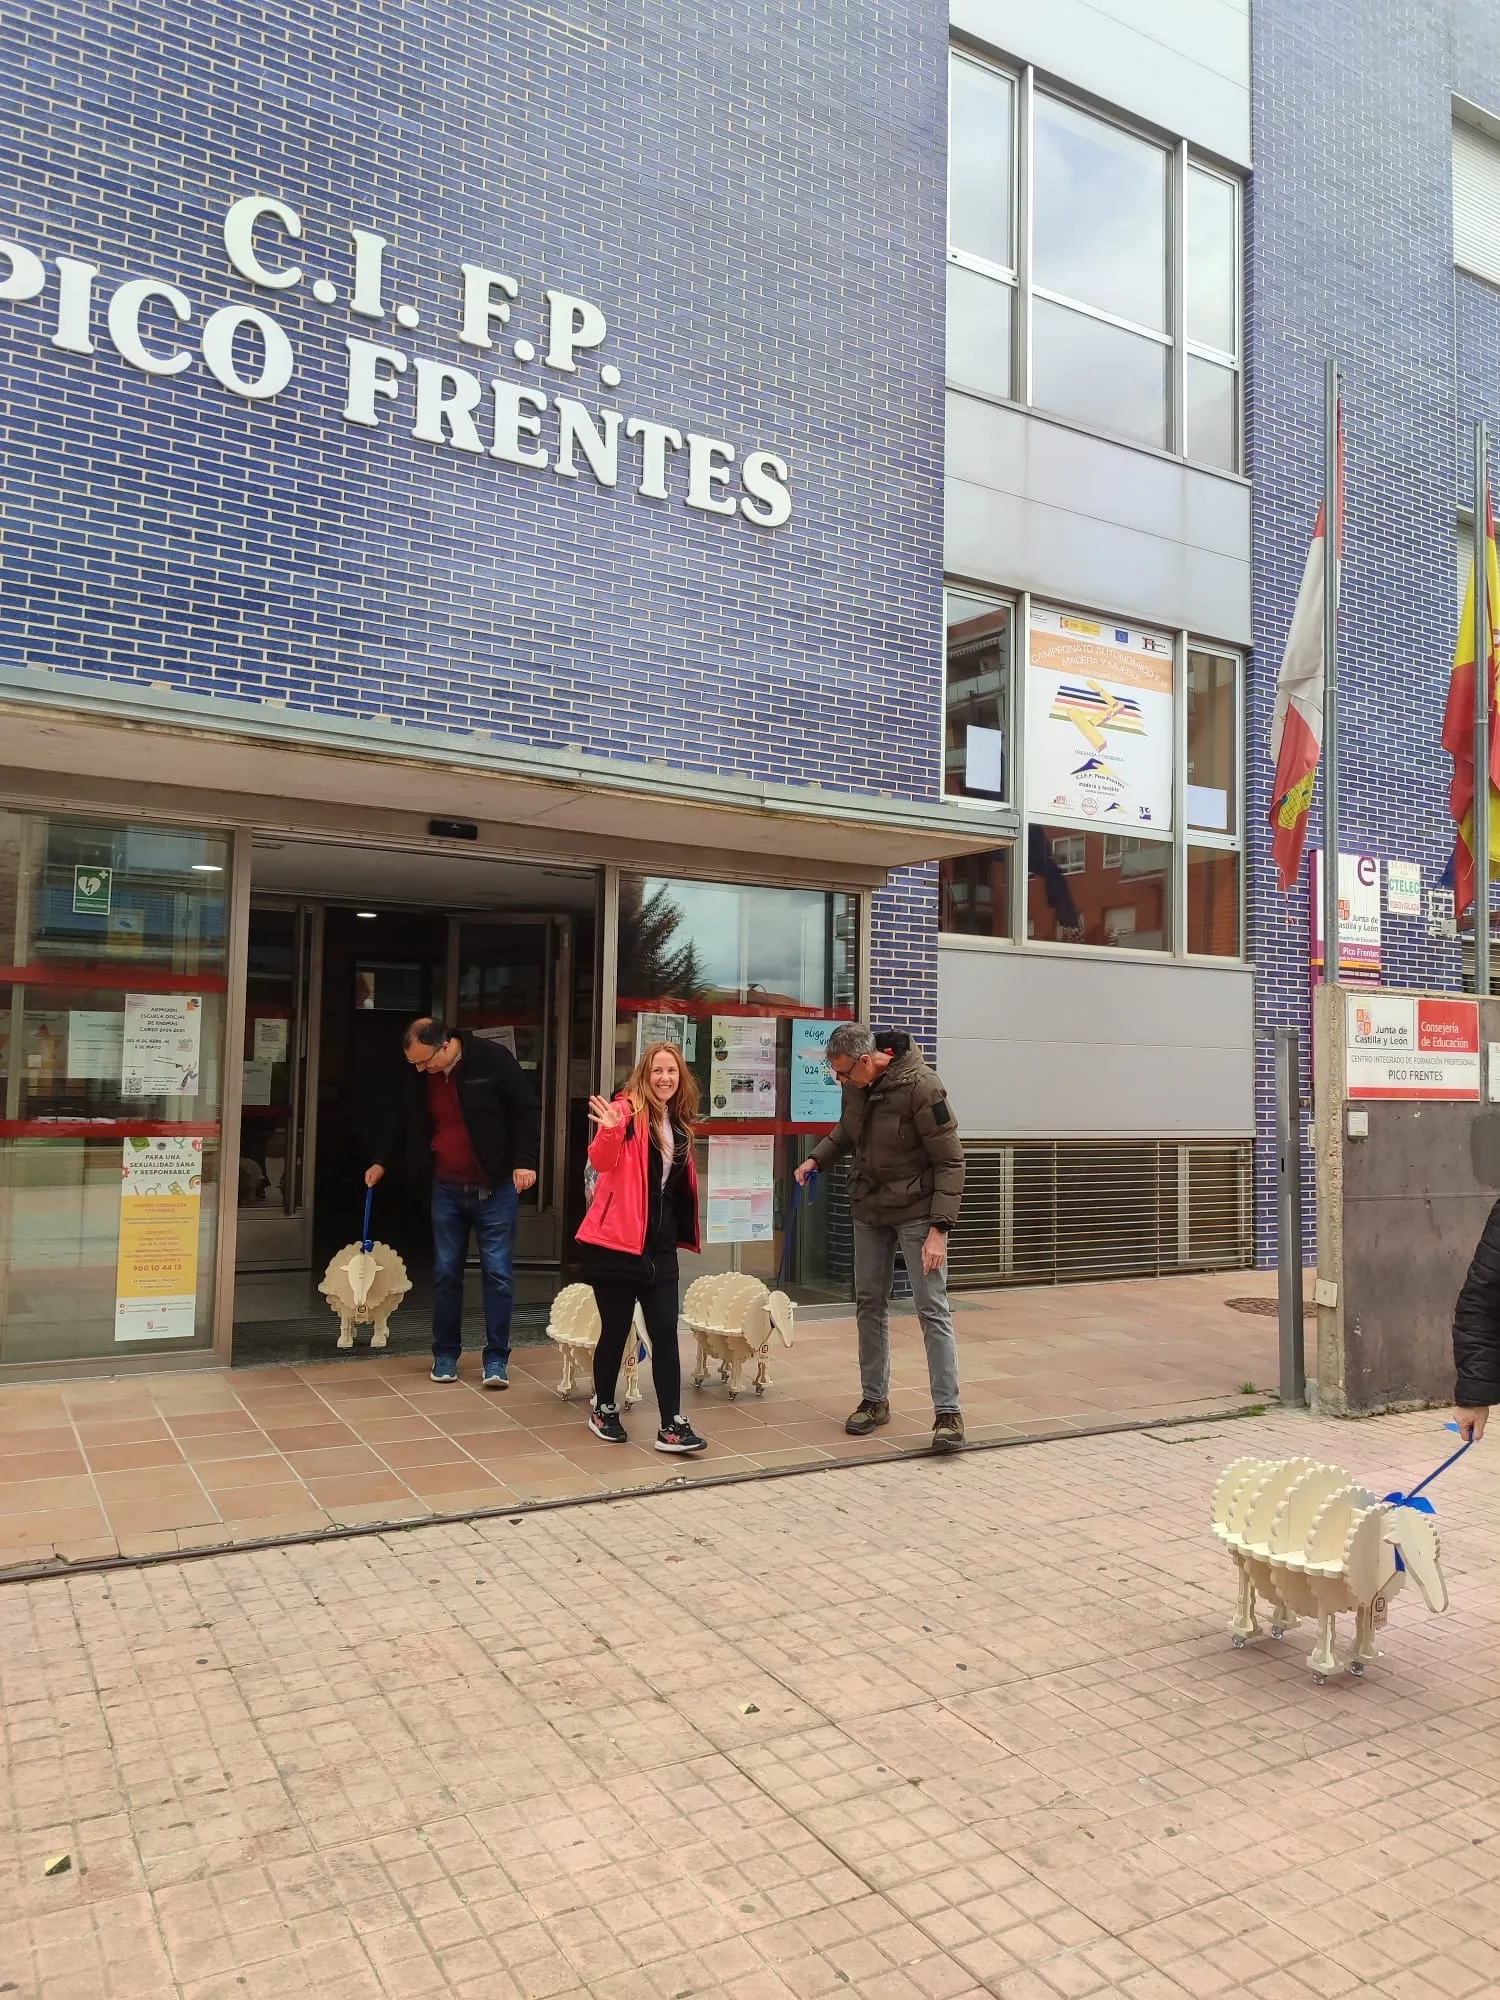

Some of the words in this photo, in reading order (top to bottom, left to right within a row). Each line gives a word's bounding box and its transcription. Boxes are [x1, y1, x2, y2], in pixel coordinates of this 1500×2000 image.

[342, 337, 793, 528] FRENTES
[1357, 855, 1377, 886] e
[1389, 878, 1420, 895] CTELEC
[1352, 913, 1370, 923] Junta
[1370, 915, 1378, 924] de
[1338, 922, 1356, 930] astilla
[1357, 924, 1362, 933] y
[1363, 922, 1378, 933] León
[1342, 947, 1356, 956] Pico
[1356, 947, 1379, 958] Frentes
[804, 1025, 825, 1040] elige
[1375, 1025, 1396, 1034] Junta
[1398, 1026, 1408, 1035] de
[1421, 1021, 1459, 1035] Consejería
[1355, 1034, 1381, 1045] Castilla
[1382, 1036, 1388, 1047] y
[1389, 1036, 1408, 1046] León
[1421, 1036, 1430, 1047] de
[1432, 1036, 1469, 1048] Educación
[1351, 1055, 1373, 1063] CENTRO
[1373, 1055, 1405, 1065] INTEGRADO
[1405, 1056, 1413, 1064] DE
[1443, 1057, 1477, 1067] PROFESIONAL
[1388, 1069, 1407, 1080] PICO
[1409, 1070, 1443, 1081] FRENTES
